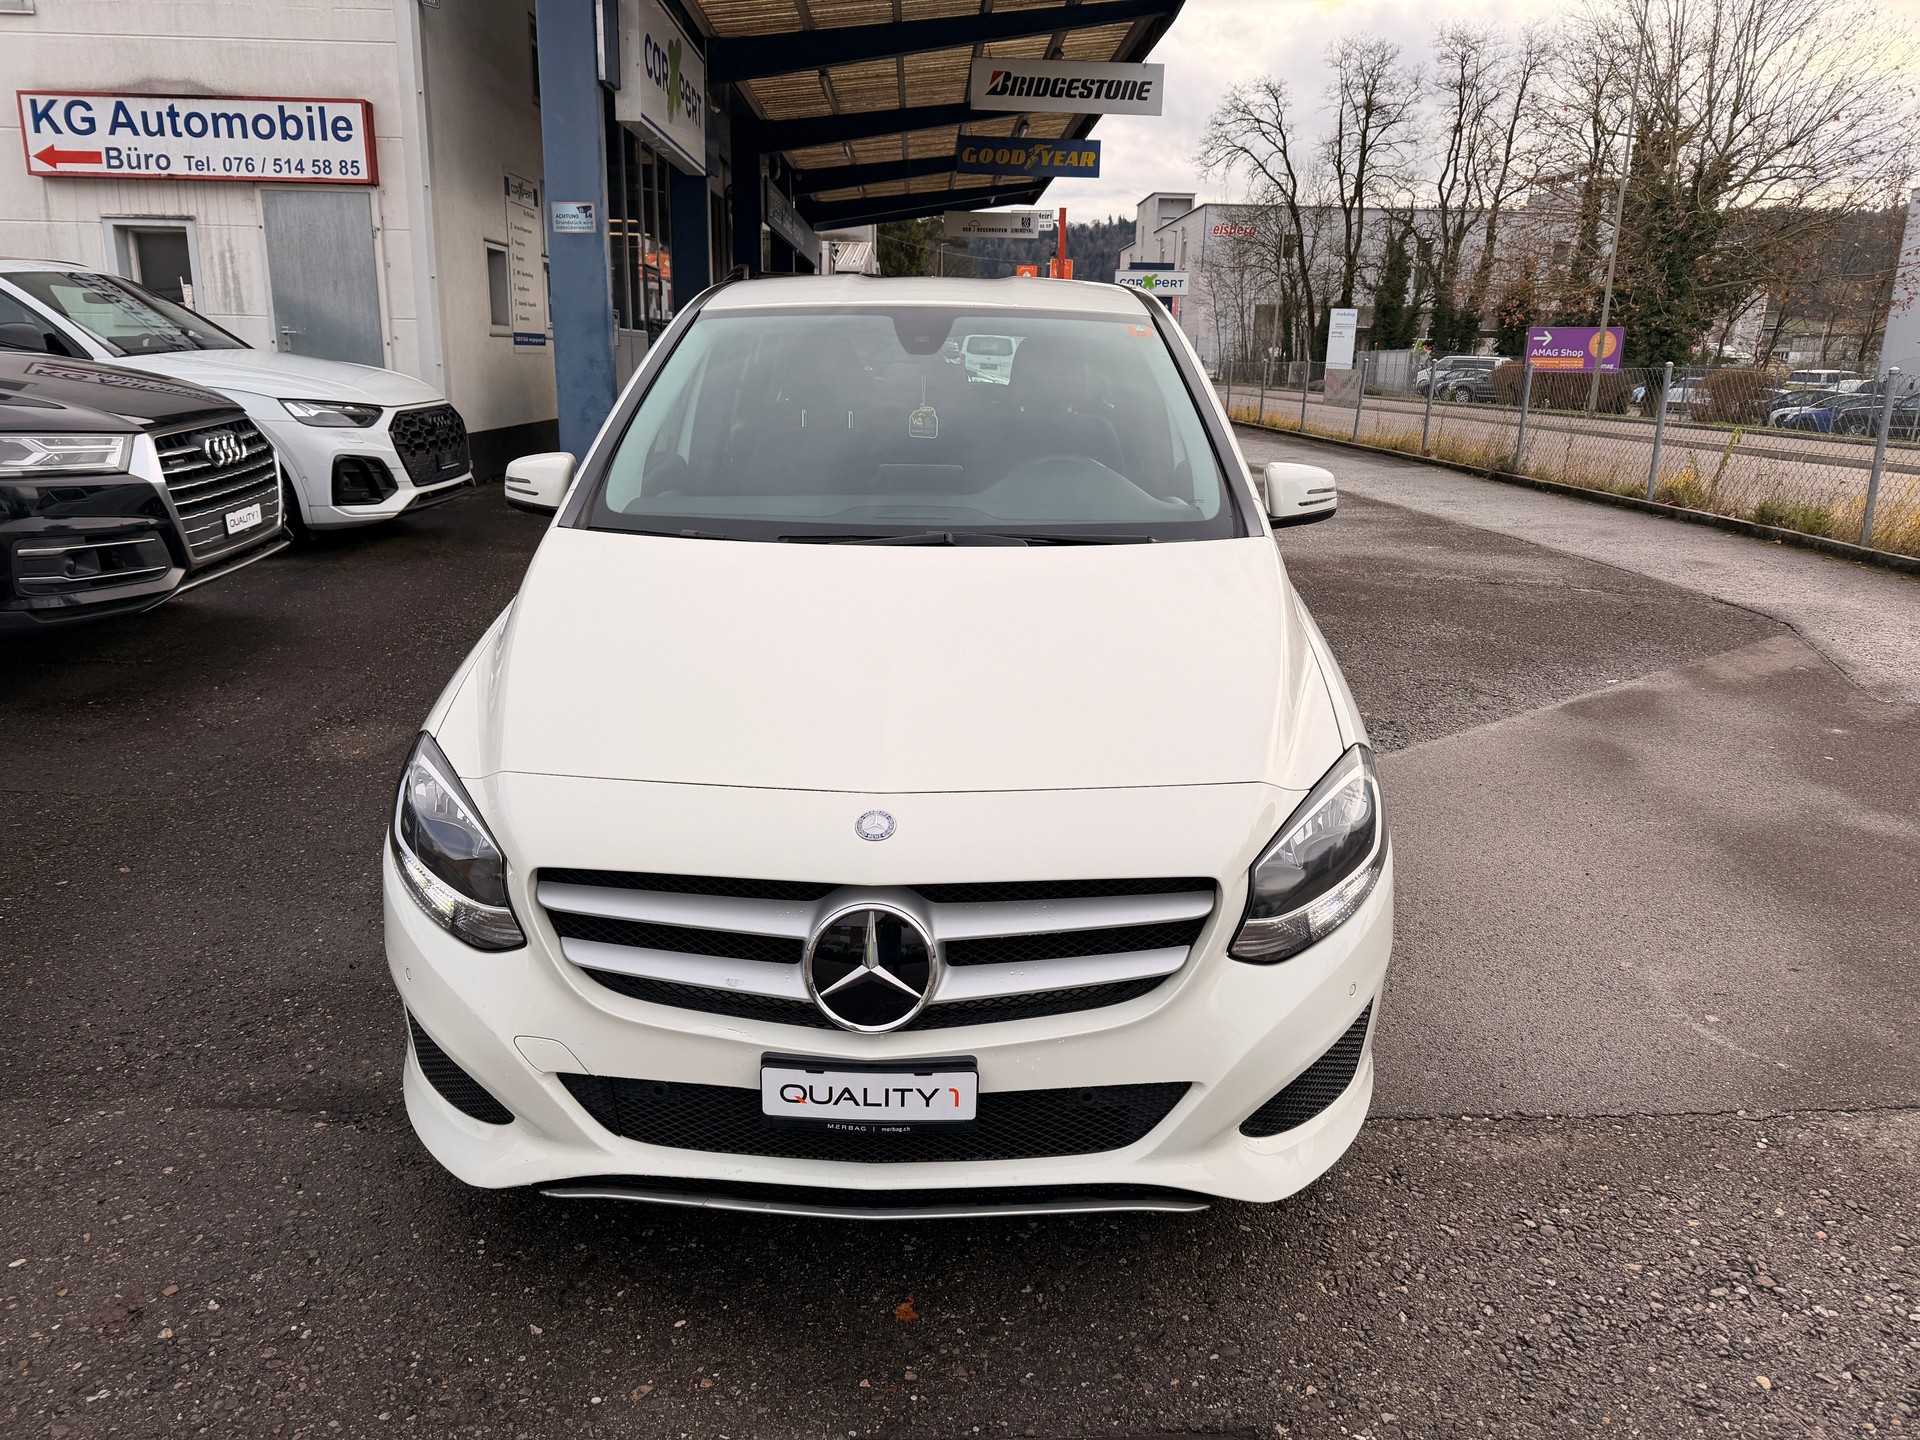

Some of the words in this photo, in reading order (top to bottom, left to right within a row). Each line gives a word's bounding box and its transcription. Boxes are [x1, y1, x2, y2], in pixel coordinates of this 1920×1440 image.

[985, 70, 1153, 101] BRIDGESTONE
[29, 98, 97, 136] KG
[108, 100, 354, 142] Automobile
[104, 146, 171, 171] Büro
[183, 155, 217, 172] Tel.
[222, 156, 255, 173] 076
[272, 158, 305, 174] 514
[311, 159, 333, 176] 58
[339, 160, 361, 176] 85
[1212, 222, 1258, 238] eisberg
[1531, 348, 1559, 357] AMAG
[1560, 348, 1584, 358] Shop
[229, 511, 256, 528] QUALITY
[779, 1083, 941, 1108] QUALITY
[948, 1087, 960, 1108] 1
[827, 1123, 867, 1132] MERBAG
